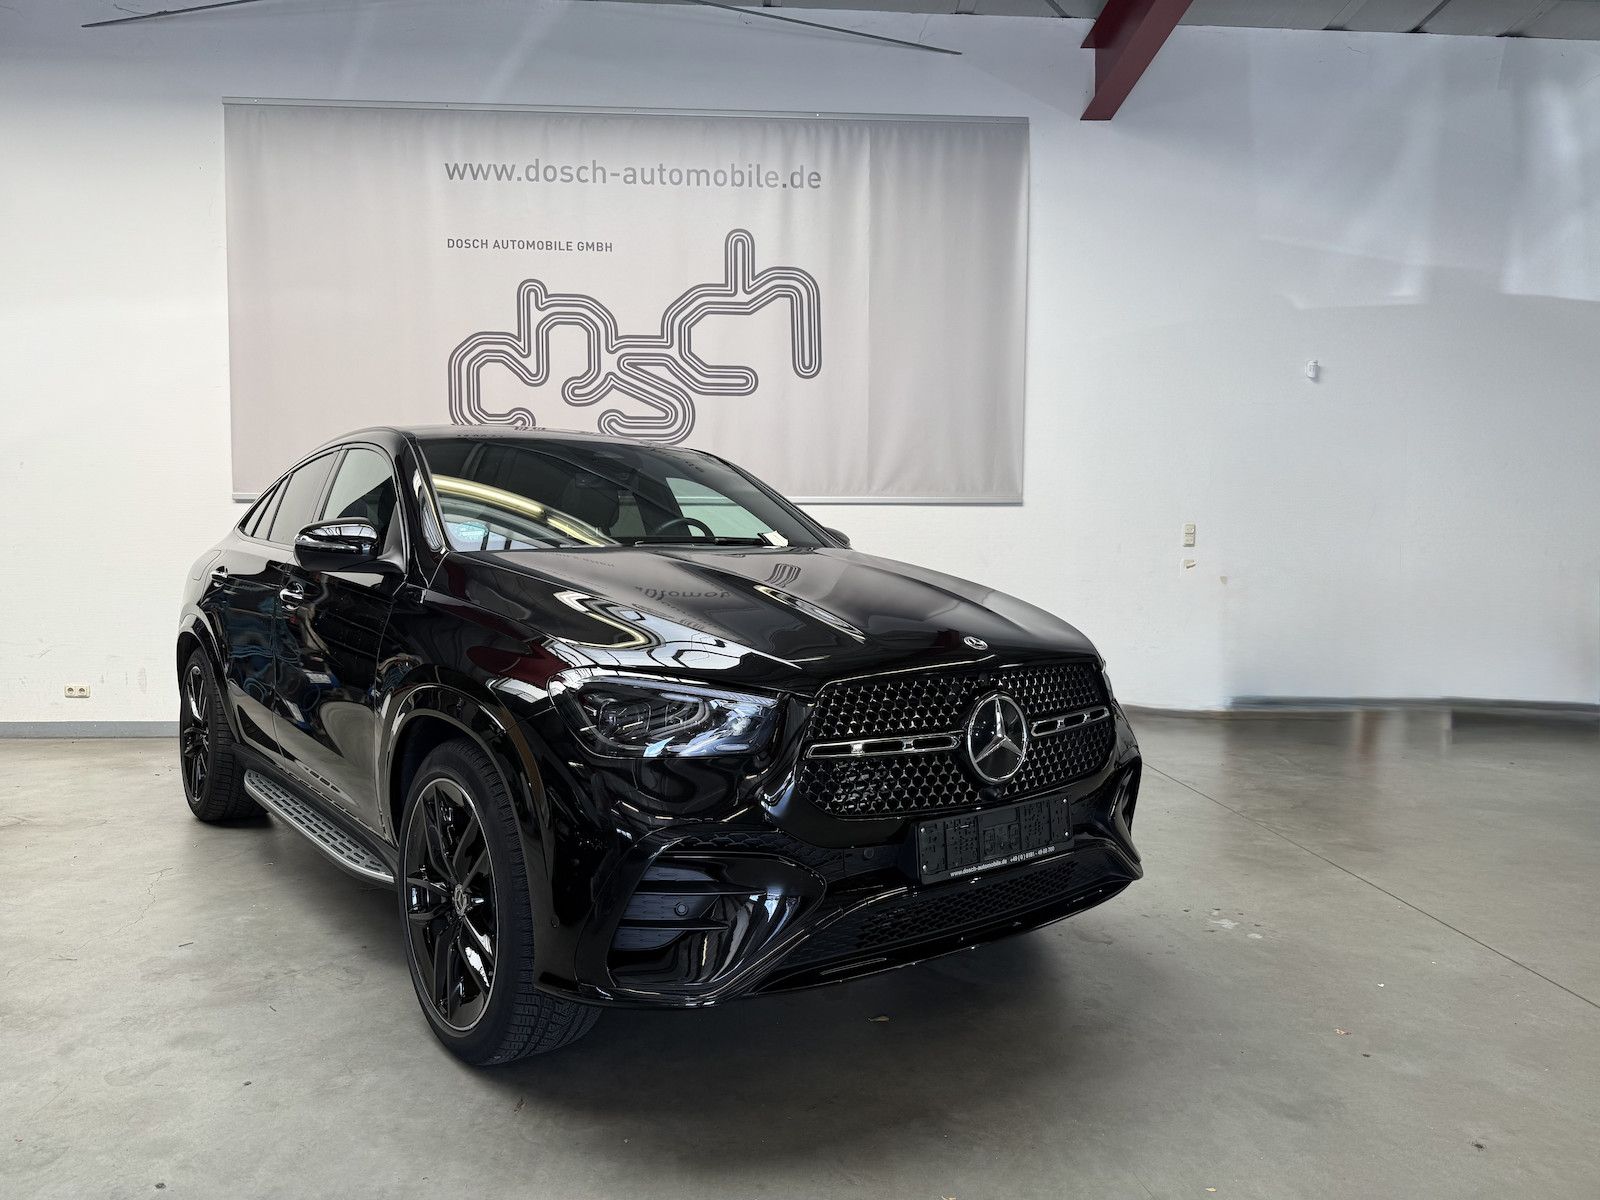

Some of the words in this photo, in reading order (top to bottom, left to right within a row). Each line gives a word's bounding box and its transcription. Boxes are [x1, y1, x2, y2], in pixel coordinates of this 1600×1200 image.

[445, 158, 822, 189] www.dosch-automobile.de
[446, 238, 489, 249] DOSCH
[492, 239, 573, 251] AUTOMOBILE
[576, 241, 613, 252] GMBH
